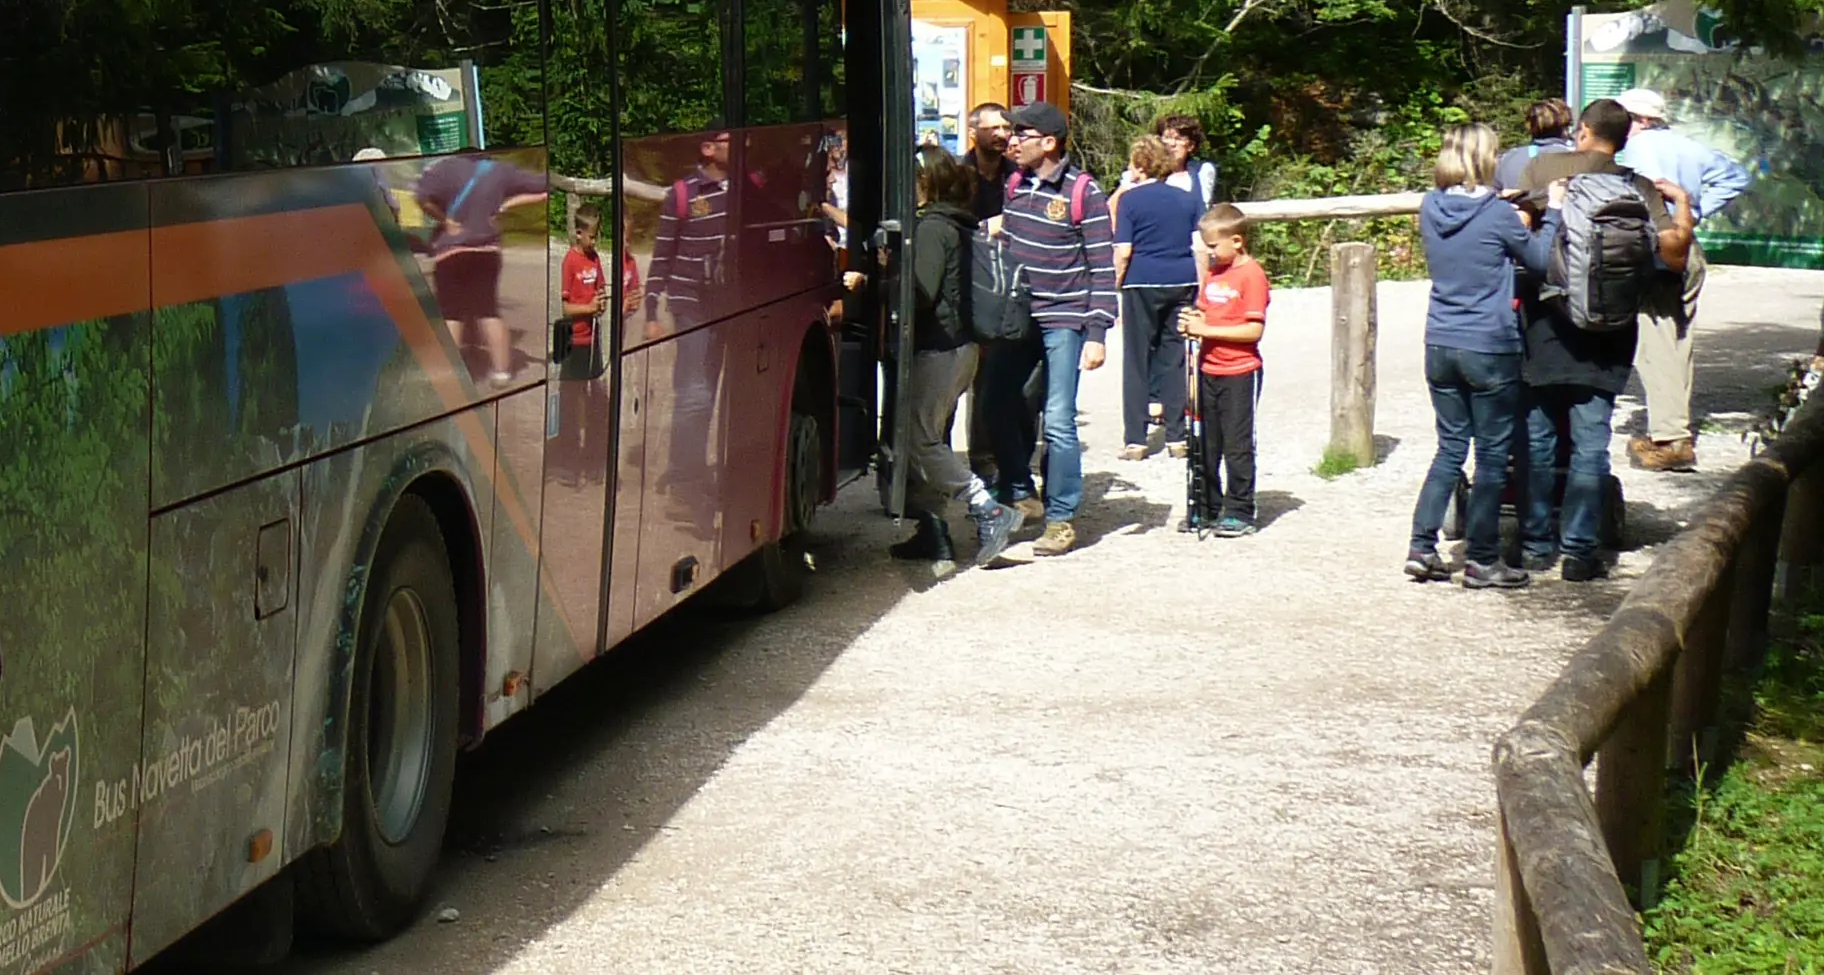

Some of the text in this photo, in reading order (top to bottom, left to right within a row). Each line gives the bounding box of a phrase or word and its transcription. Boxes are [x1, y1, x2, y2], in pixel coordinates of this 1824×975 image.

[94, 777, 127, 830] Bus
[131, 733, 203, 809] Navetta
[205, 713, 232, 767] del
[233, 699, 280, 752] Parco
[18, 886, 72, 936] NATURALE
[30, 909, 71, 950] BRENTA
